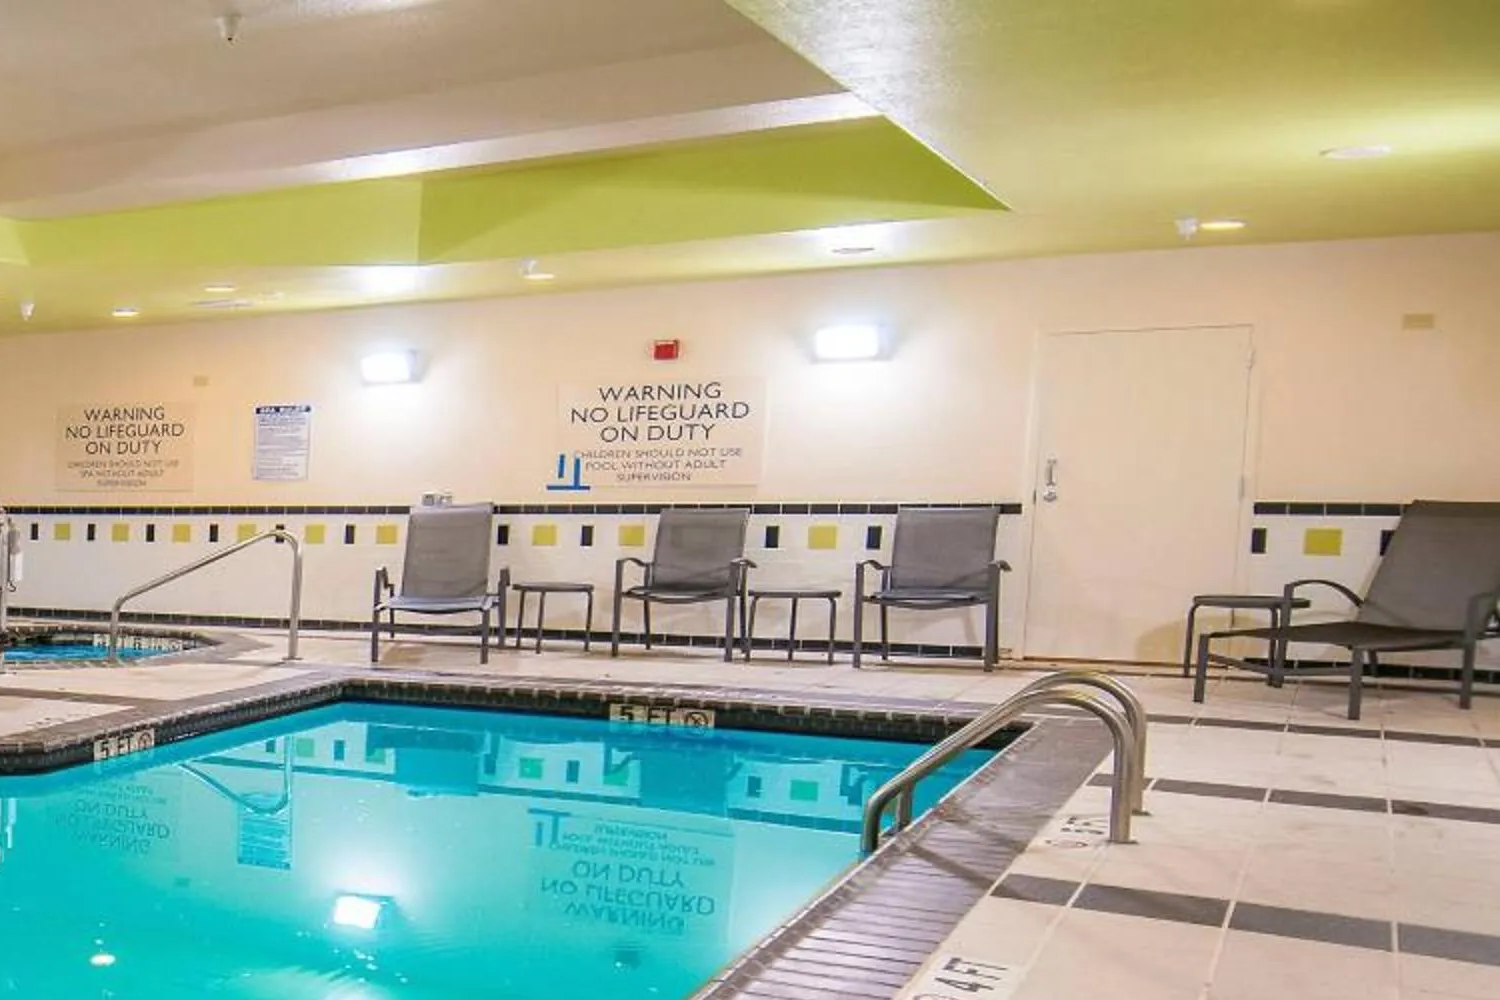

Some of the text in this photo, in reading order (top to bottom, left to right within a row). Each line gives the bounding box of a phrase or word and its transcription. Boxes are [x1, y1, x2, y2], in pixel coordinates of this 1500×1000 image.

[599, 382, 721, 402] WARNING
[84, 407, 165, 421] WARNING
[571, 402, 749, 424] NO LIFEGUARD
[65, 423, 184, 439] NO LIFEGUARD
[601, 423, 715, 443] ON DUTY
[85, 440, 161, 455] ON DUTY
[635, 448, 684, 459] SHOULD
[687, 447, 716, 457] NOT
[621, 460, 680, 471] WITHOUT
[684, 459, 726, 470] ADULT
[617, 472, 691, 482] SUPERVISION
[647, 706, 677, 726] FT
[943, 957, 1008, 981] FT
